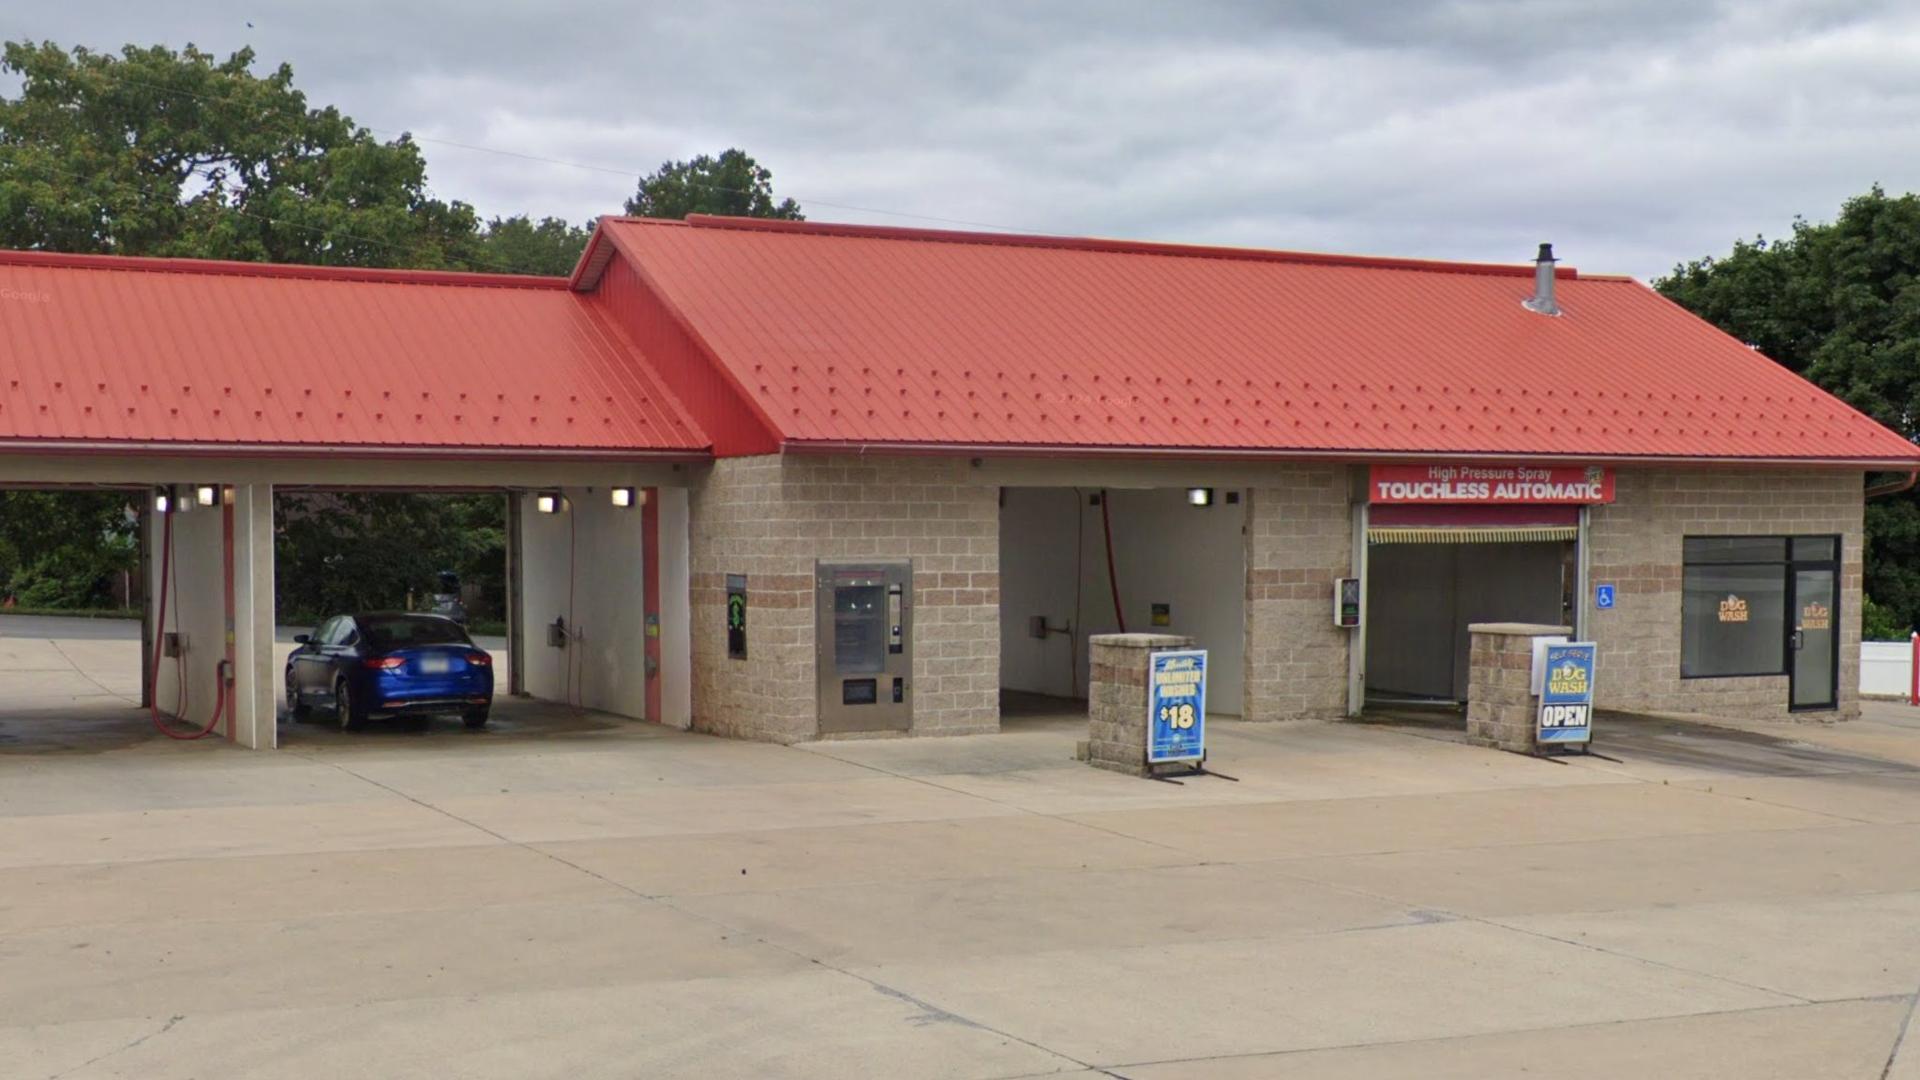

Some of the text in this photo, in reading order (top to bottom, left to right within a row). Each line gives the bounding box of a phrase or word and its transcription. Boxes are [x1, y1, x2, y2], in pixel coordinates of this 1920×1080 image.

[1429, 467, 1552, 483] High Pressure Spray
[1378, 482, 1602, 499] TOUCHLESS AUTOMATIC
[1718, 611, 1748, 622] WASH
[1550, 681, 1588, 694] WASH
[1160, 704, 1194, 729] $18
[1542, 706, 1587, 727] OPEN
